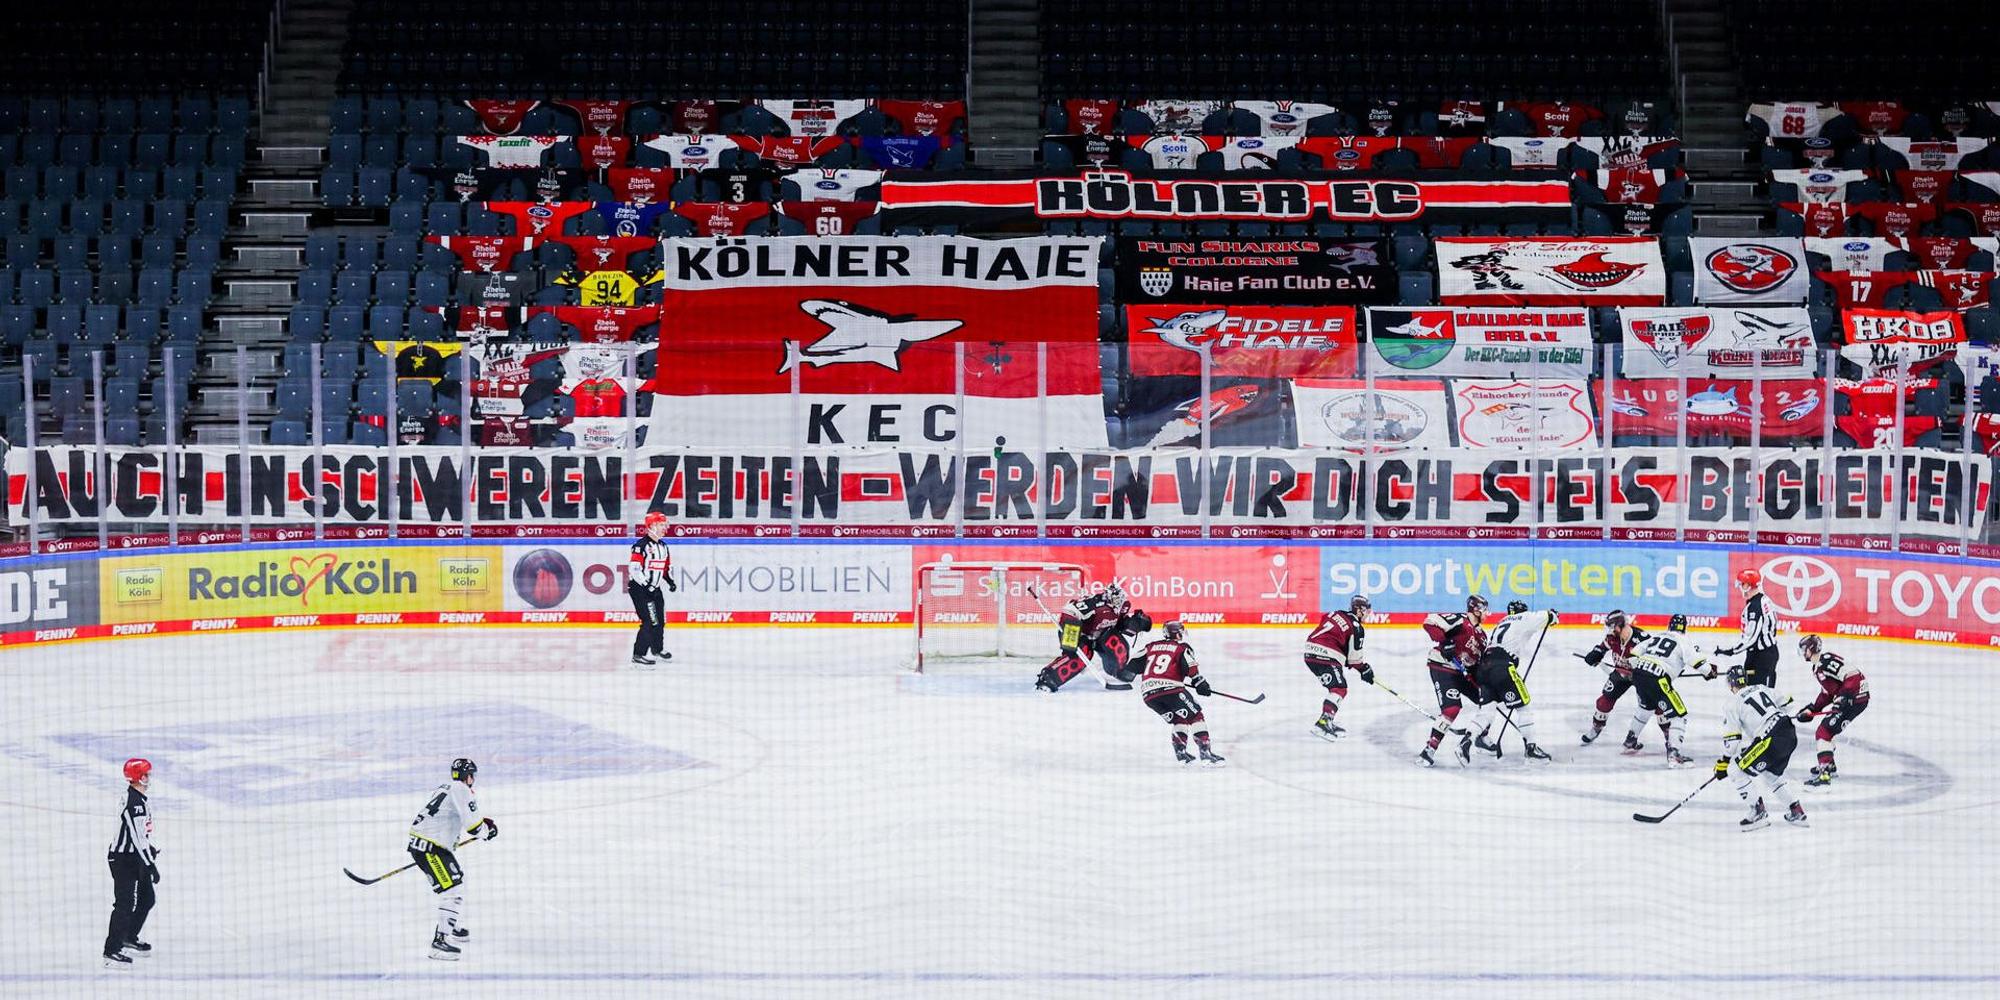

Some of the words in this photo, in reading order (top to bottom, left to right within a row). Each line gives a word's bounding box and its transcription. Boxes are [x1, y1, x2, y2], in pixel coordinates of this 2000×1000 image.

[1544, 112, 1570, 122] Scott
[1783, 114, 1805, 135] 68
[1162, 144, 1188, 153] Scott
[732, 182, 744, 203] 3
[1036, 171, 1311, 218] KÖLNER
[1330, 178, 1422, 219] EC
[816, 216, 842, 235] 60
[1137, 241, 1195, 254] FUN
[1200, 240, 1320, 254] SHARKS
[472, 250, 500, 258] Energie
[677, 239, 911, 281] KÖLNER
[942, 244, 1090, 281] HAIE
[1168, 256, 1299, 267] COLOGNE
[1184, 275, 1233, 292] Haie
[1238, 275, 1278, 290] Fan
[1284, 275, 1331, 290] Club
[1336, 275, 1376, 290] e.V.
[597, 280, 621, 299] 94
[1850, 281, 1872, 302] 17
[1217, 316, 1344, 333] FIDELE
[1219, 333, 1328, 350] HAIE
[1484, 330, 1528, 342] EIFEL
[22, 449, 204, 519] AUCH
[225, 454, 286, 518] IN
[301, 454, 622, 522] SCHWEREN
[649, 454, 840, 519] ZEITEN
[899, 451, 1152, 520] WERDEN
[1175, 454, 1296, 518] WIR
[1313, 456, 1452, 522] DICH
[1483, 455, 1662, 525] STETS
[1688, 453, 1983, 530] BEGLEITEN
[367, 528, 383, 536] OTT
[527, 527, 543, 535] OTT
[686, 527, 701, 535] OTT
[765, 527, 780, 535] OTT
[843, 527, 859, 535] OTT
[923, 527, 938, 535] OTT
[1083, 528, 1099, 536] OTT
[1100, 528, 1145, 536] IMMOBILIEN
[1162, 528, 1178, 536] OTT
[1242, 528, 1257, 536] OTT
[1259, 528, 1304, 536] IMMOBILIEN
[1320, 528, 1336, 536] OTT
[1399, 528, 1415, 536] OTT
[1416, 528, 1460, 536] IMMOBILIEN
[1637, 530, 1653, 538] OTT
[1718, 532, 1733, 540] OTT
[132, 537, 147, 545] OTT
[209, 533, 224, 541] OTT
[1796, 535, 1812, 543] OTT
[449, 564, 480, 575] Radio
[125, 574, 155, 586] Radio
[189, 561, 305, 600] Radio
[325, 559, 417, 597] Köln
[453, 576, 477, 587] Köln
[582, 564, 629, 594] OT
[1330, 556, 1718, 597] sportwetten.de
[129, 586, 152, 598] Köln
[1311, 621, 1334, 639] 7
[1144, 654, 1172, 676] 19
[1744, 691, 1777, 717] 14
